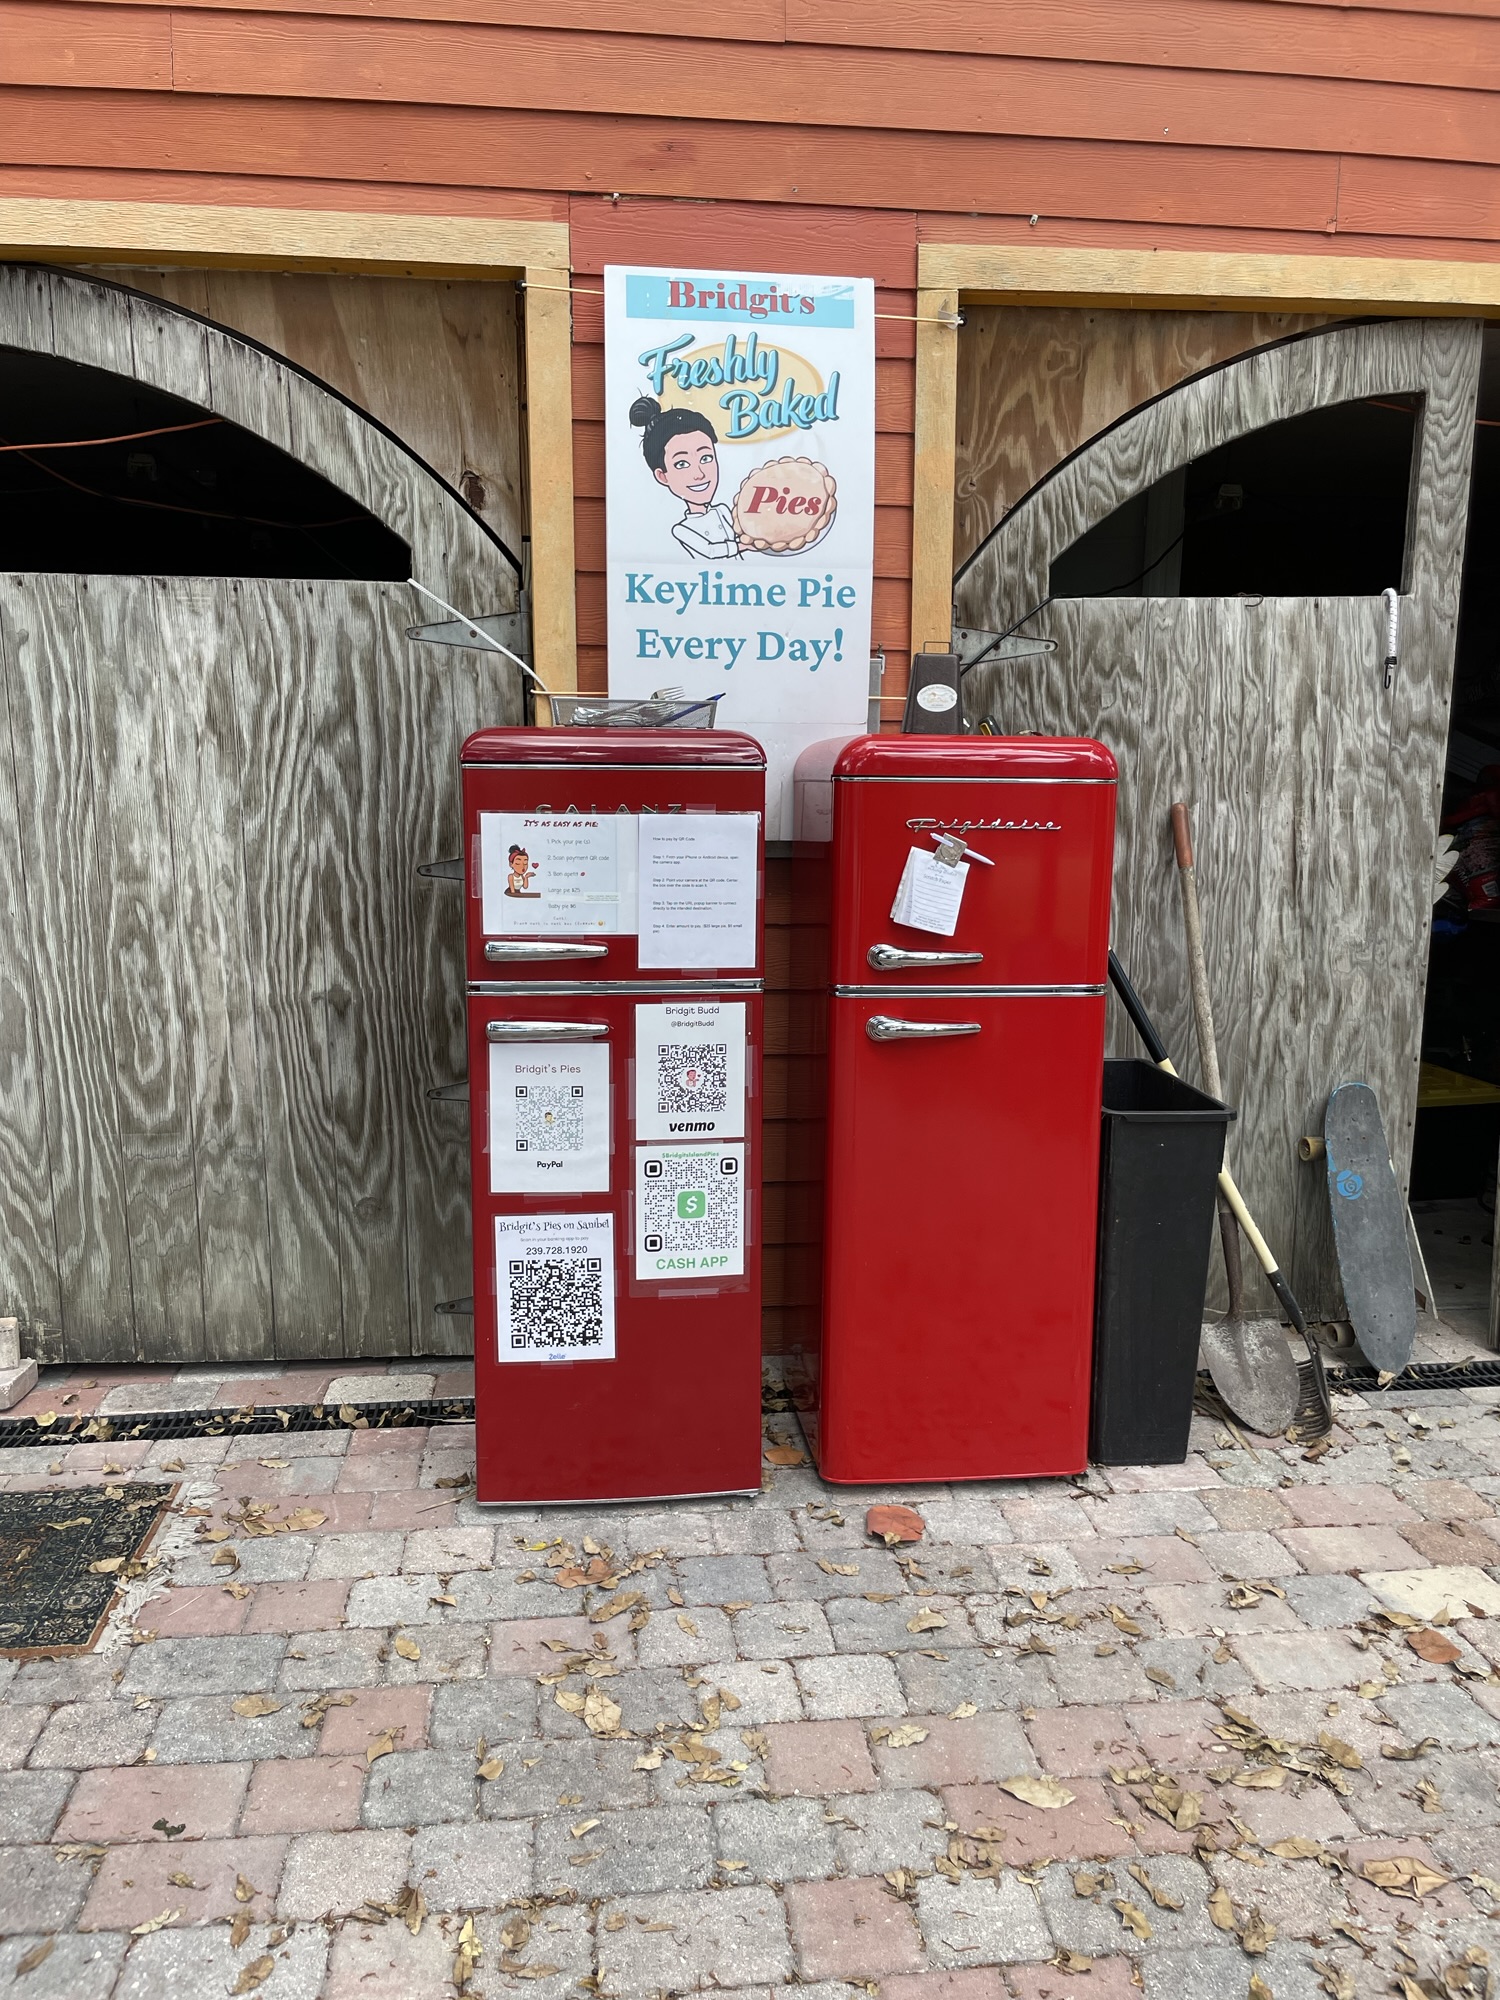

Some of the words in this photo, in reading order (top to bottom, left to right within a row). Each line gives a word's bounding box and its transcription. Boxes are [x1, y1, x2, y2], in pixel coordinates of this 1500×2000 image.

[666, 280, 816, 320] Bridgit's
[638, 331, 780, 399] Freshly
[719, 370, 841, 439] Baked
[743, 484, 823, 517] Pies
[625, 570, 787, 617] Keylime
[797, 574, 857, 610] Pie
[636, 628, 747, 671] Every
[756, 628, 845, 672] Day!
[524, 819, 540, 827] IT'S
[905, 817, 1062, 835] Frigidaire
[665, 1006, 696, 1016] Bridgit
[697, 1006, 720, 1015] Budd
[670, 1020, 715, 1028] @BridgitBudd
[515, 1064, 557, 1076] Bridgit's
[560, 1064, 582, 1074] Pies
[668, 1121, 716, 1133] venmo
[536, 1160, 564, 1170] PayPal
[499, 1220, 541, 1234] Bridgit's
[543, 1220, 562, 1231] Pies
[564, 1222, 575, 1230] on
[576, 1217, 610, 1230] Sanibel
[526, 1245, 588, 1256] 239.728.1920
[656, 1257, 696, 1270] CASH
[700, 1256, 729, 1268] APP
